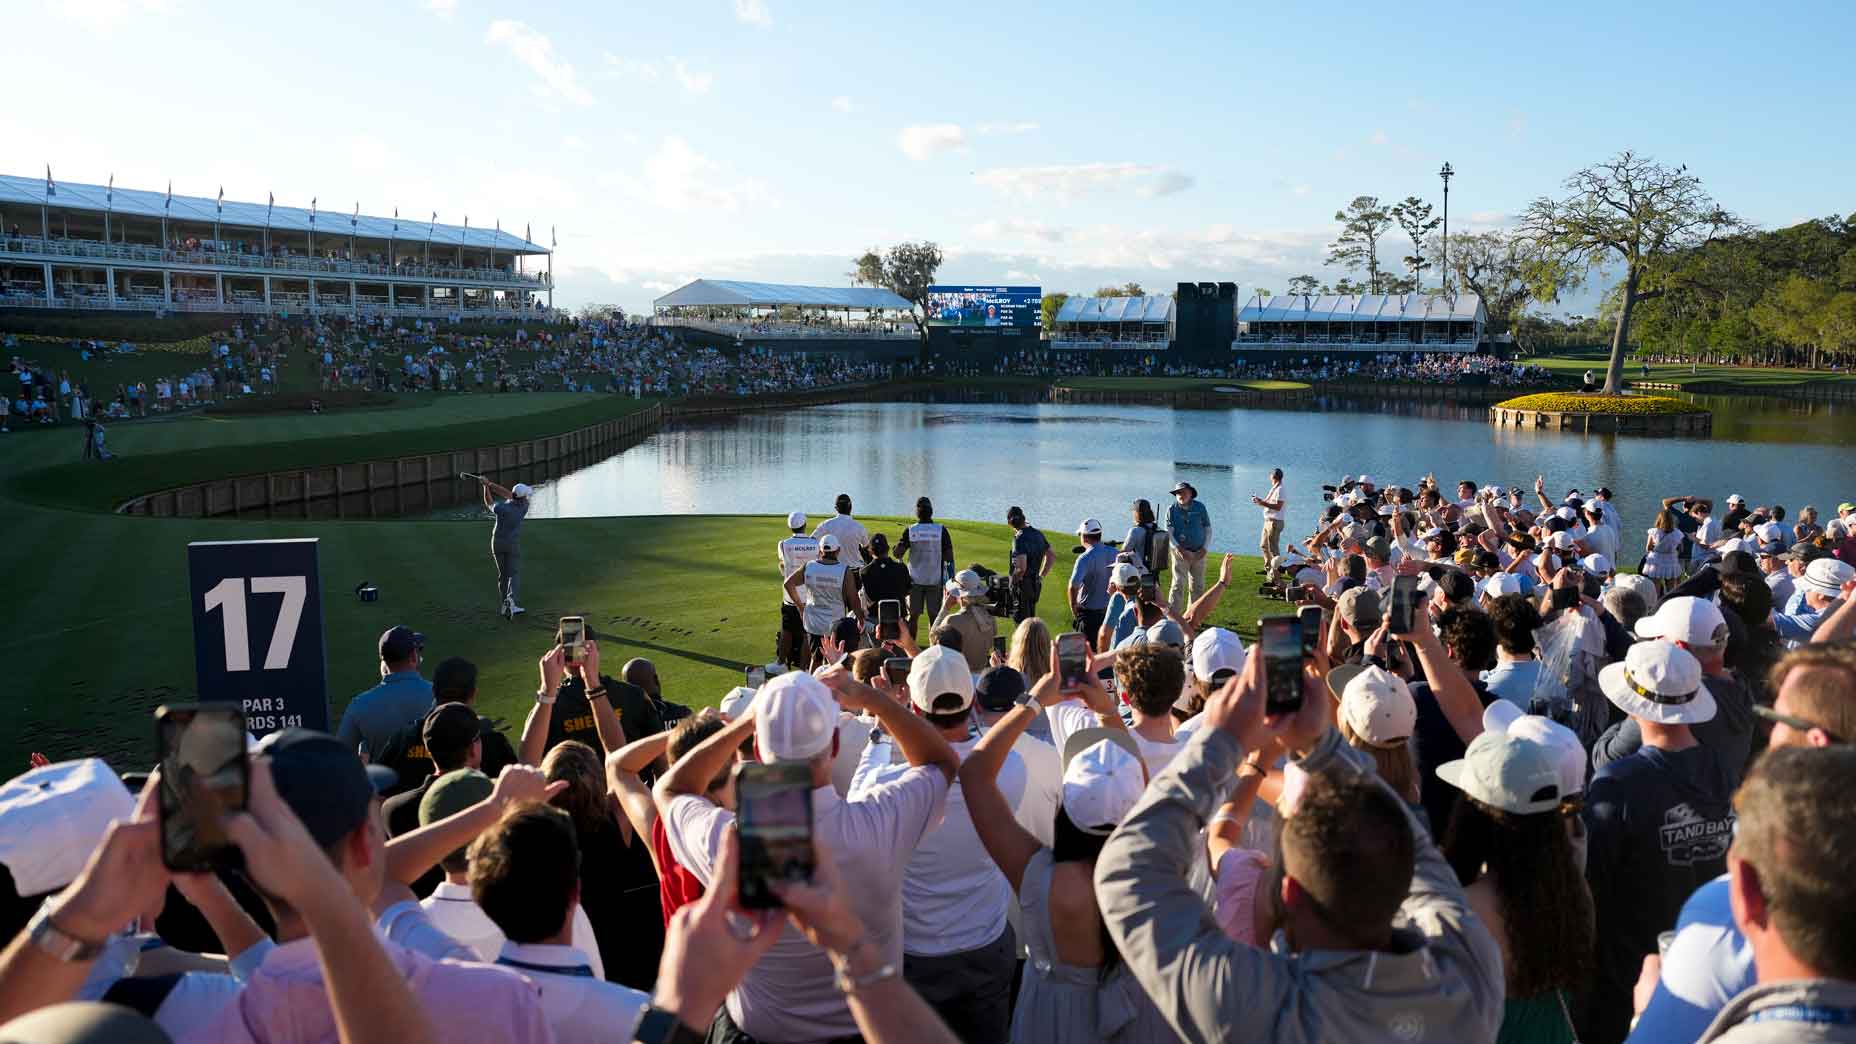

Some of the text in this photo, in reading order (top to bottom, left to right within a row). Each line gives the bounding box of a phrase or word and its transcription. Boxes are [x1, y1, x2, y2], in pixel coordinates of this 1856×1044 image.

[204, 575, 307, 672] 17
[242, 697, 285, 712] PAR 3
[246, 714, 302, 730] RDS 141
[1706, 817, 1734, 835] BAY
